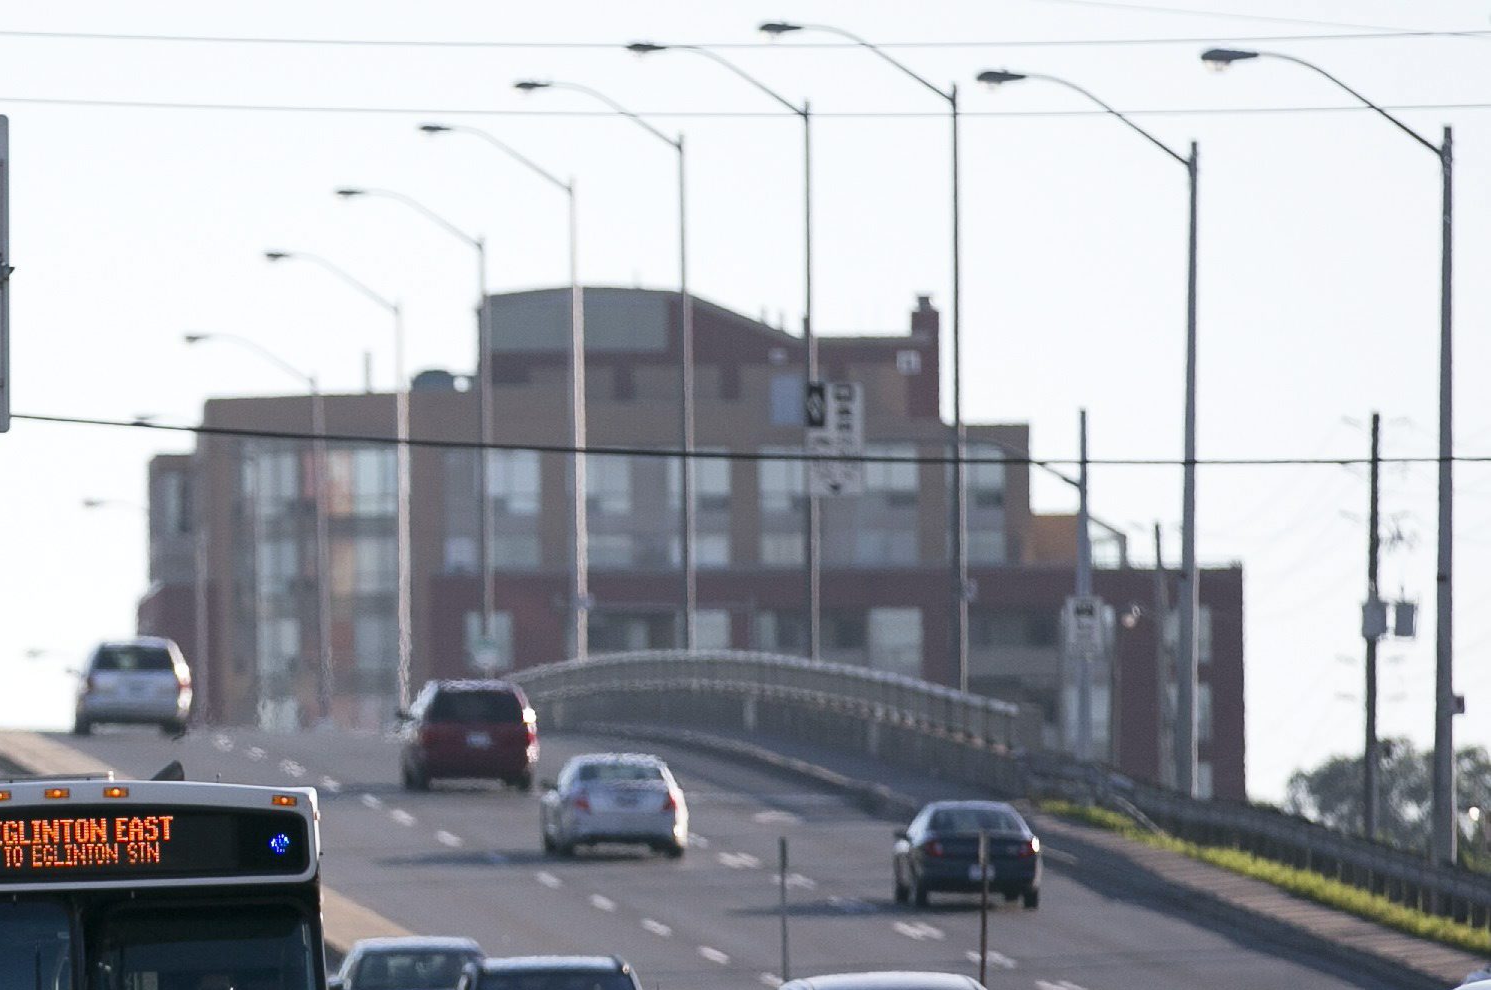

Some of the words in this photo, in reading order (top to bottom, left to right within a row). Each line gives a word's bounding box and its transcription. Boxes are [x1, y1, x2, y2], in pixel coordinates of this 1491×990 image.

[115, 815, 174, 842] EAST
[3, 846, 24, 867] TO
[32, 842, 118, 867] EGLINTON
[127, 841, 161, 864] STN
